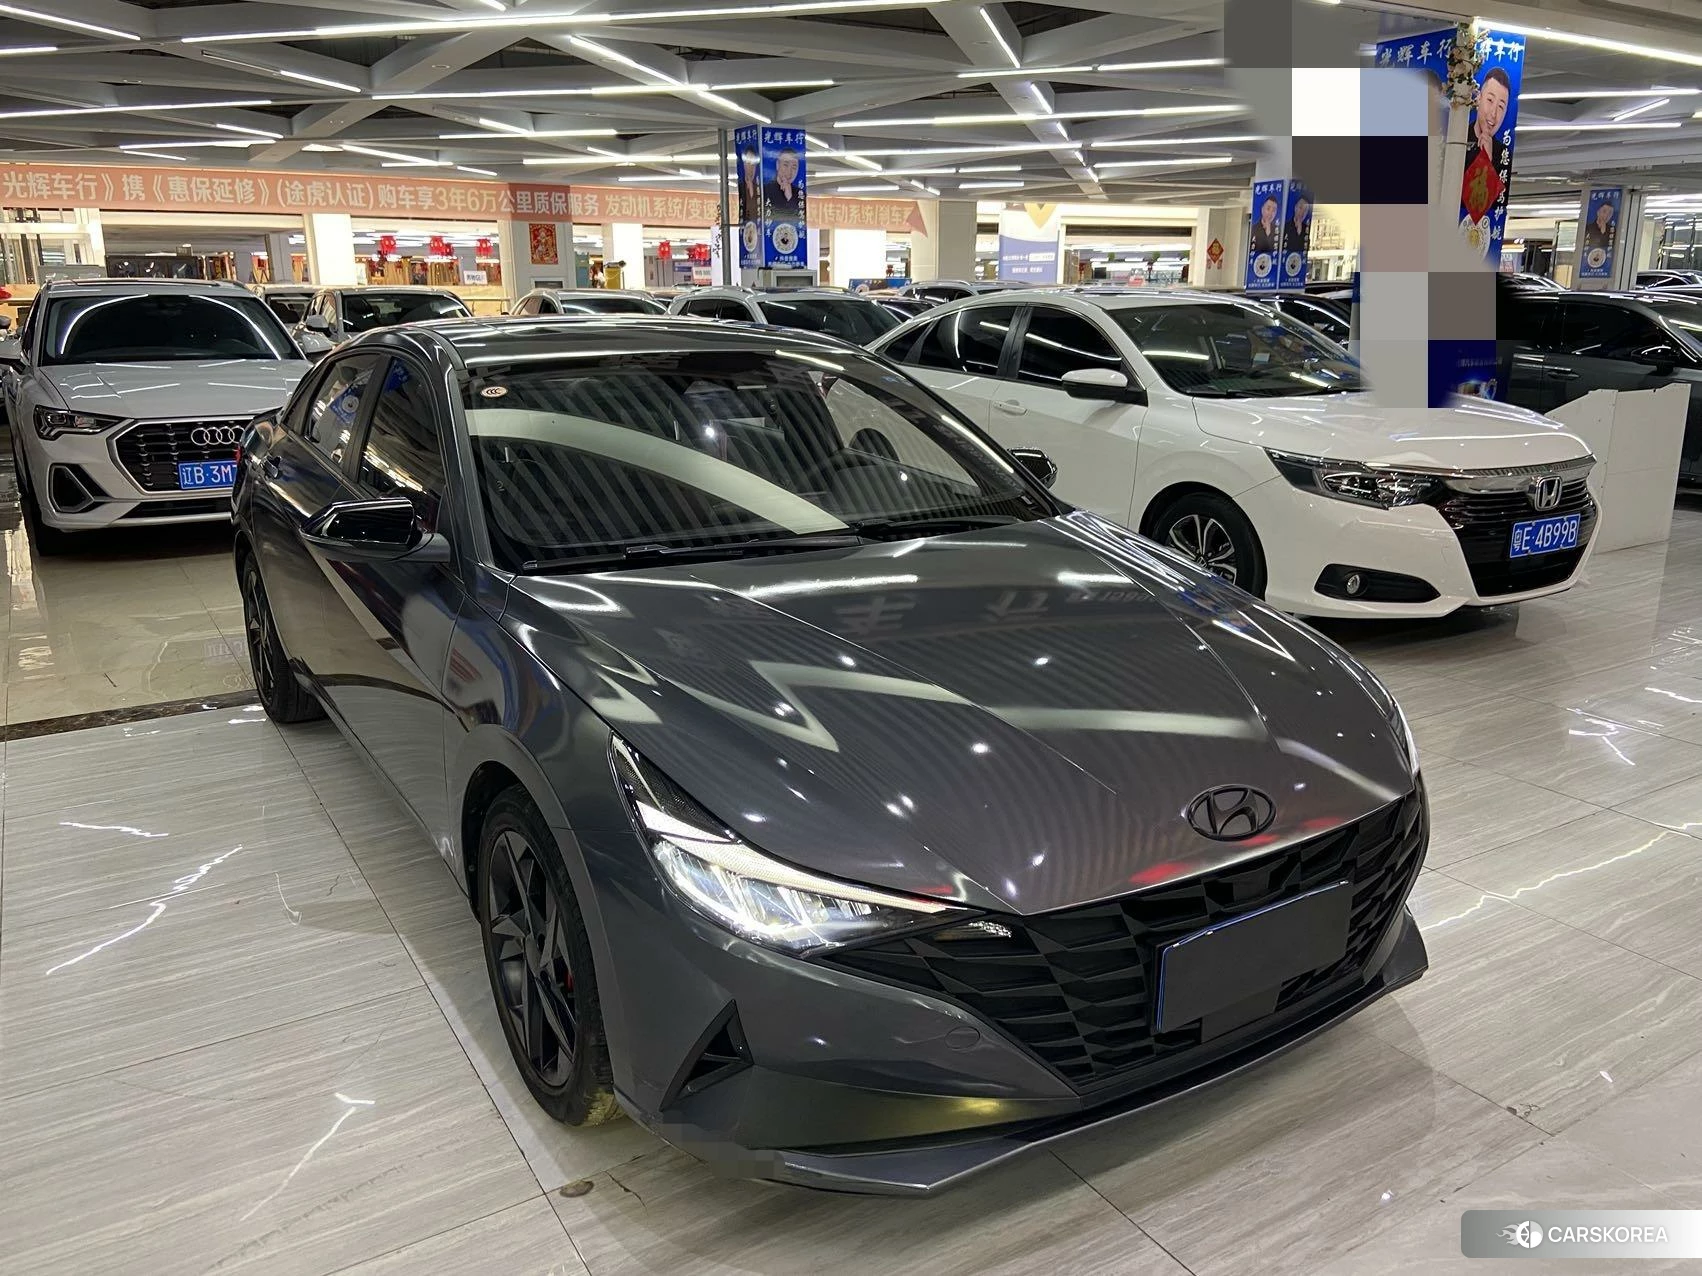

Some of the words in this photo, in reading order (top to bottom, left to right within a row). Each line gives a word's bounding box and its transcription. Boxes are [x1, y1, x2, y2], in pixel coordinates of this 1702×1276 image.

[1475, 37, 1520, 63] 辉车行
[764, 130, 804, 145] 光辉车行
[182, 465, 237, 485] 辽B·3M
